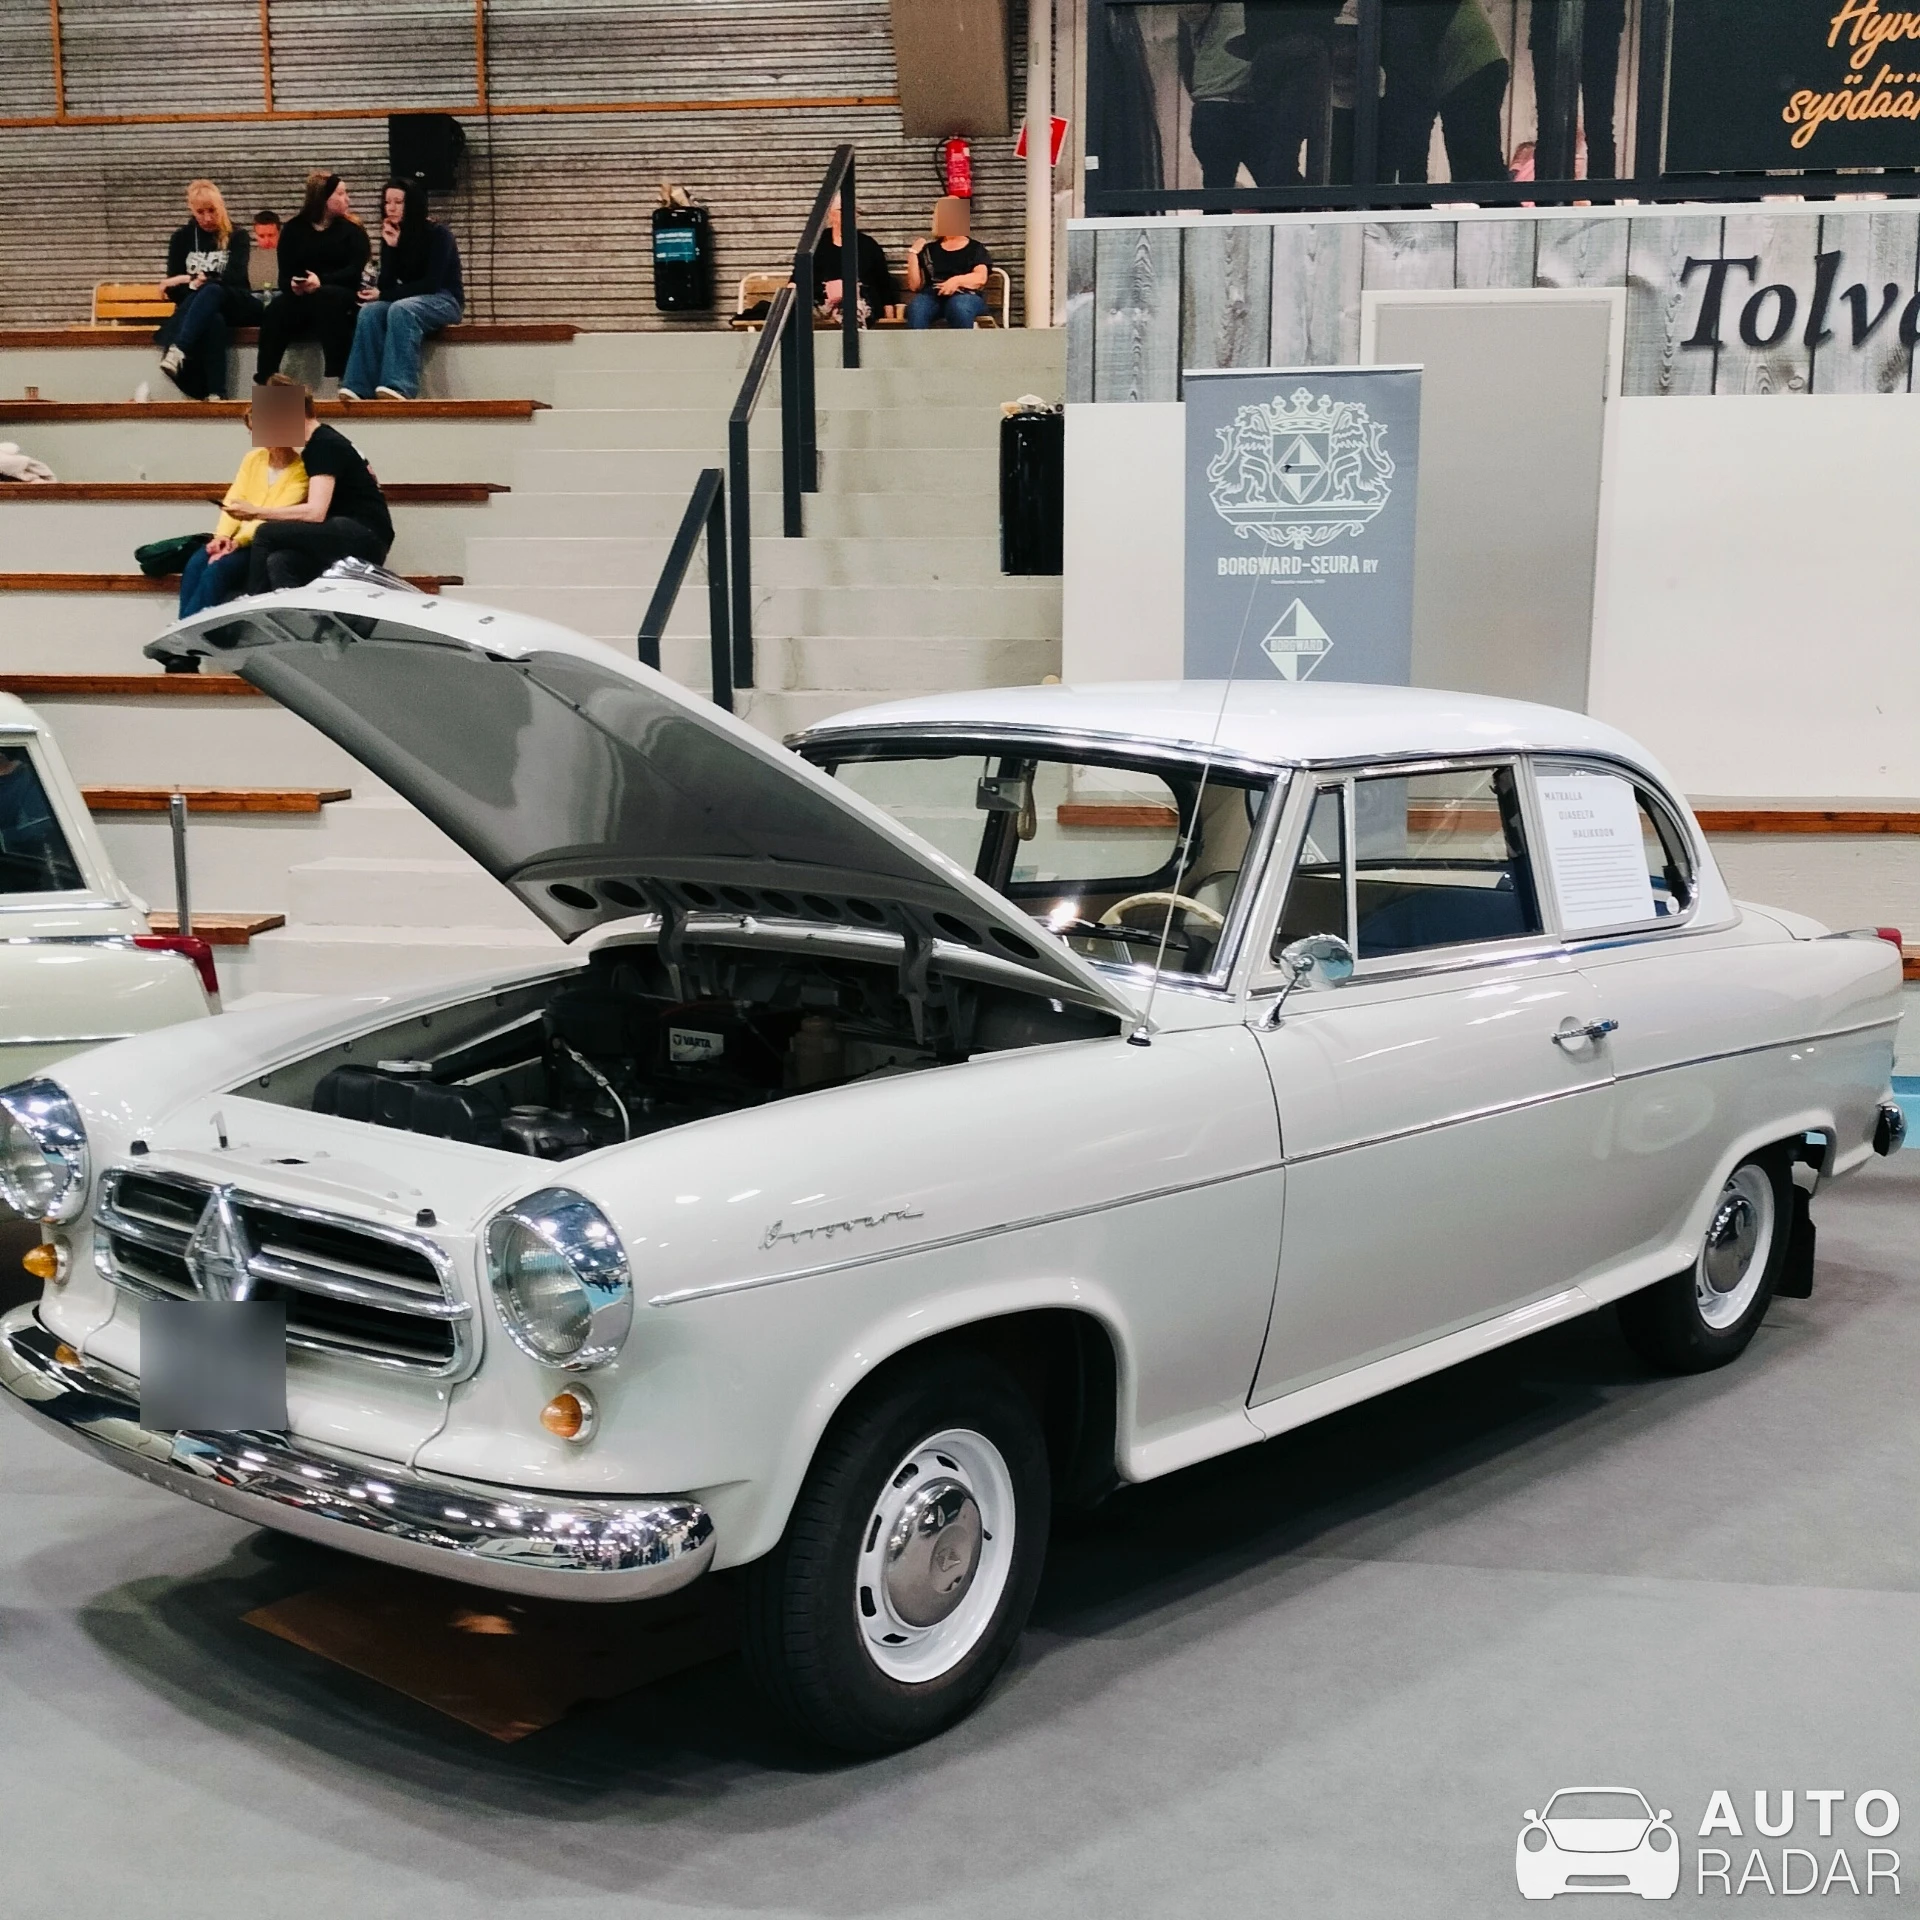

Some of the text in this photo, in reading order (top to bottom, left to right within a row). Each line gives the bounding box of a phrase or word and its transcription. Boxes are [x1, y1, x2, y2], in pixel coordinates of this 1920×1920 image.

[1217, 555, 1379, 576] BORGWARD-SEURA RY
[1270, 640, 1324, 652] BORGWARD
[1544, 791, 1583, 801] MATKALLA
[1572, 828, 1615, 839] HALIKKOON
[683, 1035, 713, 1049] VARTA
